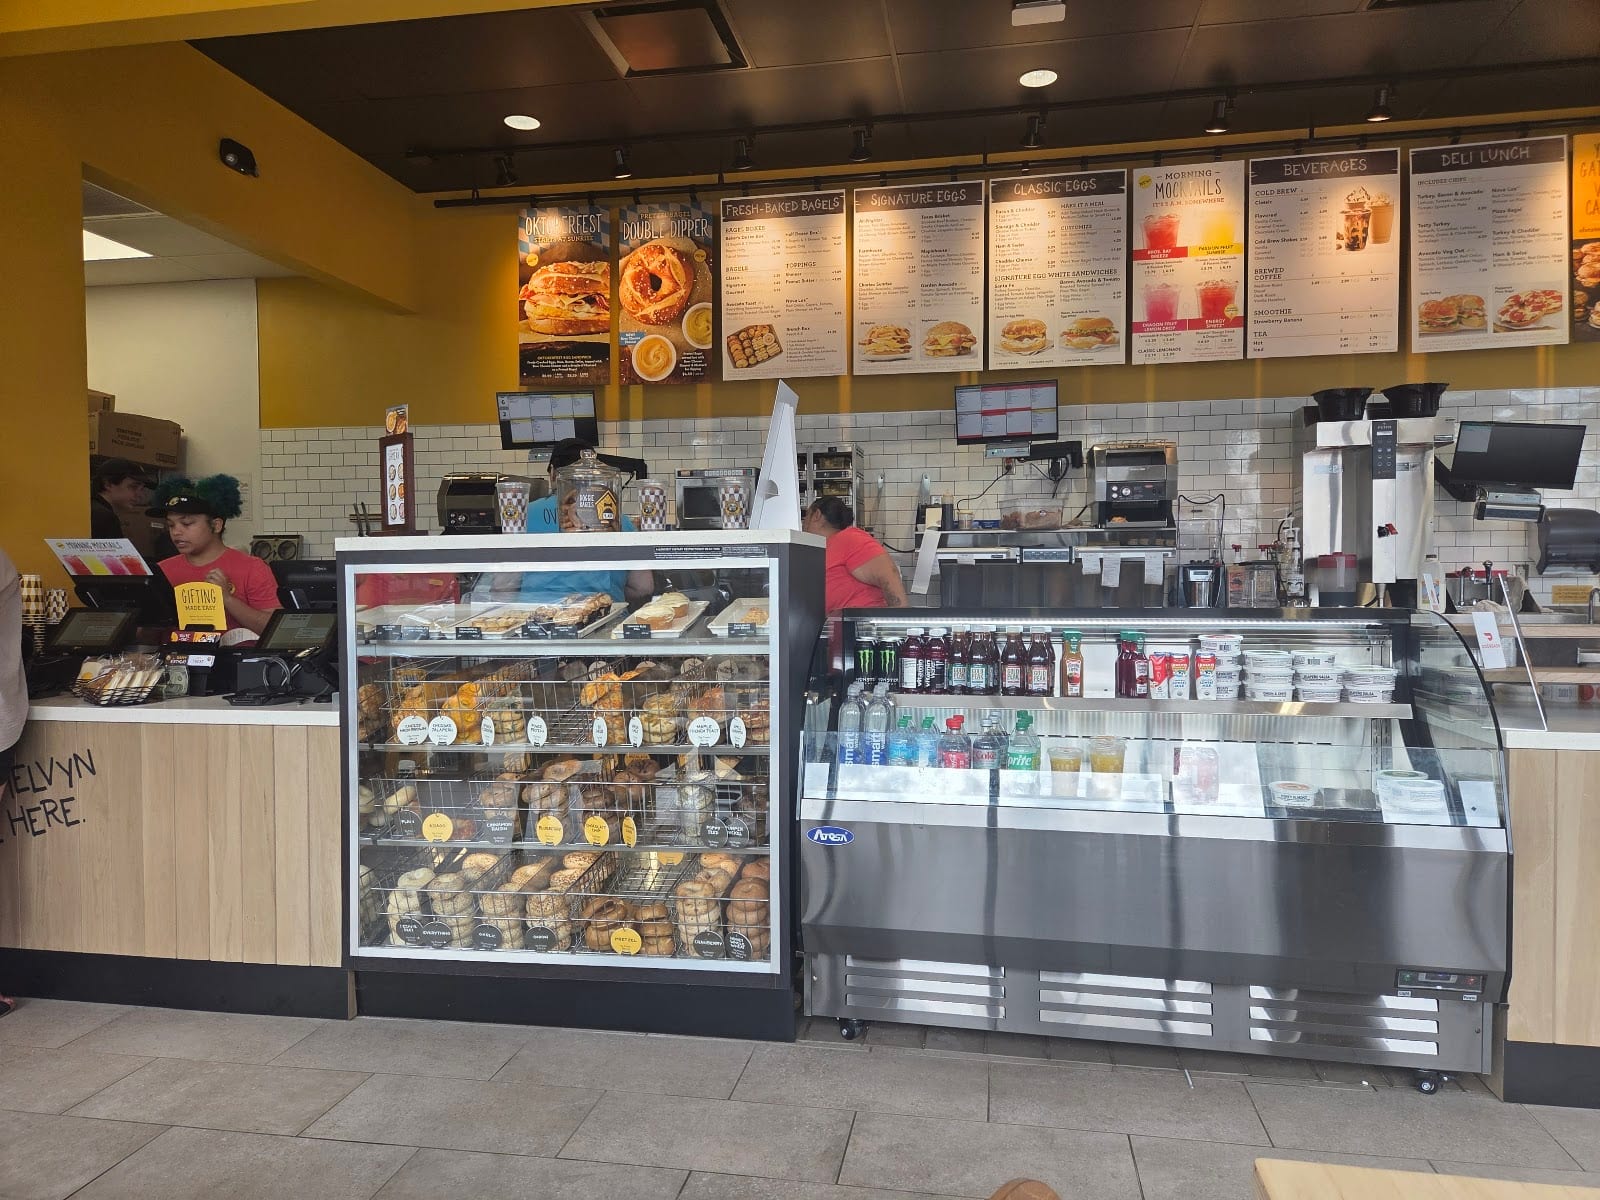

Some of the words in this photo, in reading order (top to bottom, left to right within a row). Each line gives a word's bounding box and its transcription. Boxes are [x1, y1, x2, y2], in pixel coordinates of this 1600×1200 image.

[1441, 152, 1473, 167] DELI
[1480, 147, 1530, 163] LUNCH
[1165, 170, 1212, 180] MORNING
[1284, 159, 1367, 176] BEVERAGES
[1014, 182, 1061, 196] CLASSIC
[1066, 178, 1097, 192] EGGS
[1155, 179, 1222, 199] MOCKTAILS
[726, 202, 798, 216] FRESH-BAKED
[802, 197, 840, 212] BAGELS
[870, 191, 933, 206] SIGNATURE
[937, 189, 967, 202] EGGS
[525, 213, 602, 236] OKTOBERFEST
[624, 220, 664, 240] DOUBLE
[670, 218, 709, 238] DIPPER
[1072, 269, 1117, 277] SANDWICHES
[182, 589, 216, 604] GIFTING
[845, 728, 853, 767] smart
[872, 730, 880, 768] smart
[1008, 755, 1032, 766] prite
[8, 748, 96, 798] ELVYN
[7, 797, 86, 837] HERE.
